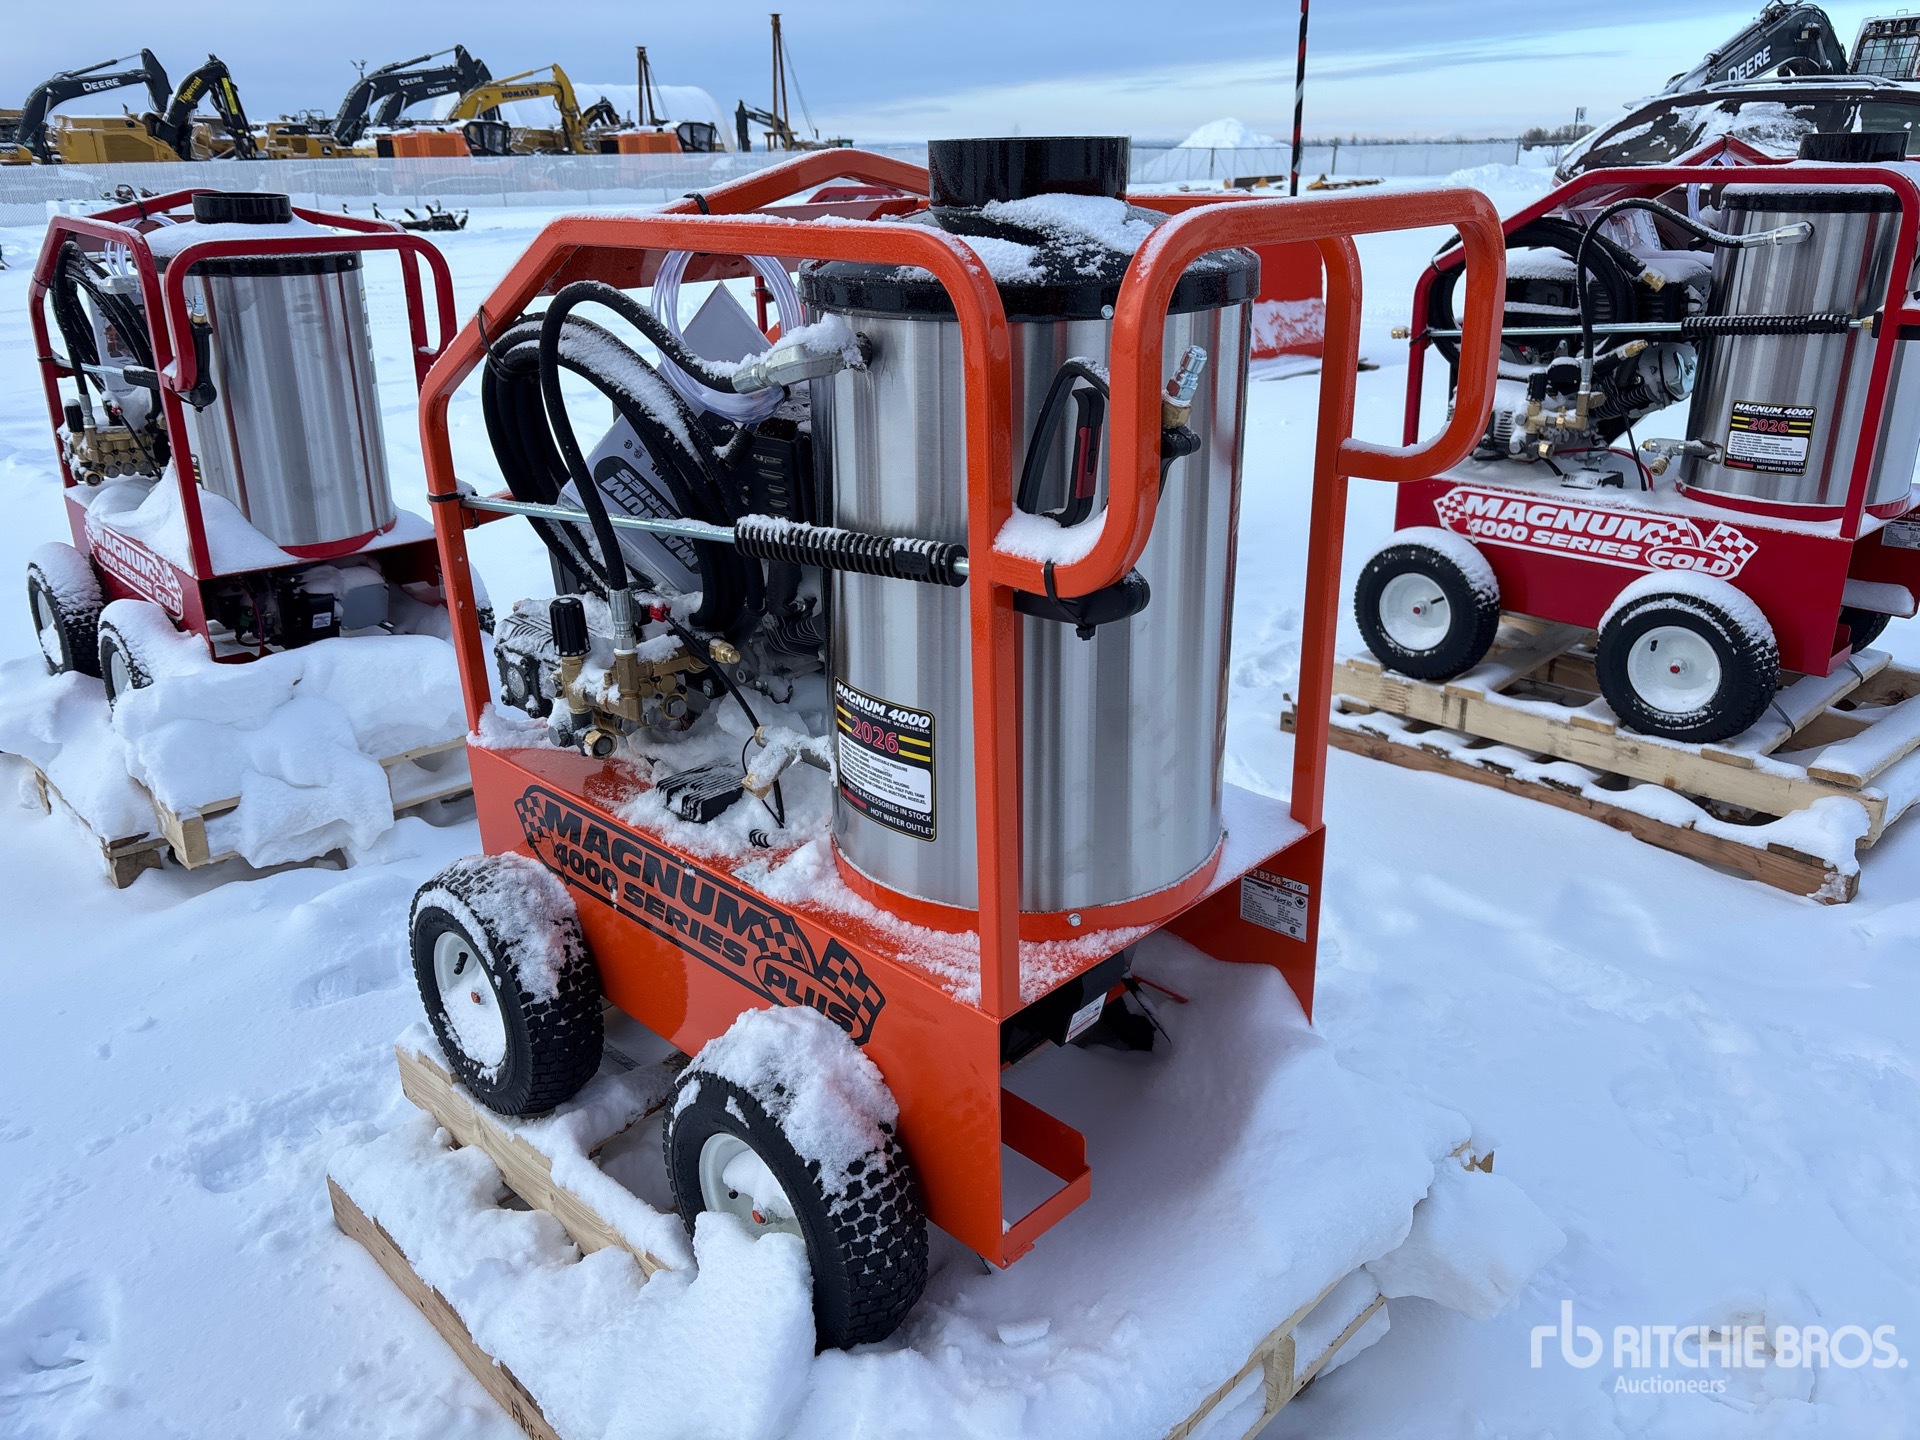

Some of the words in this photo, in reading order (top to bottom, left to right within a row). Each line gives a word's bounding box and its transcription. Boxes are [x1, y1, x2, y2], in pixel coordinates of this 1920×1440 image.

[1727, 44, 1772, 81] DEERE
[82, 78, 121, 92] DEERE
[177, 76, 203, 104] Tigercat
[399, 76, 424, 86] DEERE
[426, 86, 448, 95] DEERE
[501, 89, 540, 99] KOMATSU
[1734, 403, 1783, 414] MAGNUM
[1748, 418, 1789, 433] 2026
[1463, 493, 1659, 544] MAGNUM
[1466, 518, 1529, 543] 4000
[1530, 531, 1641, 560] SERIES
[1650, 549, 1733, 576] GOLD
[118, 562, 152, 594] SERIES
[155, 588, 181, 613] GOLD
[837, 682, 886, 716] MAGNUM
[888, 709, 930, 728] 4000
[844, 700, 860, 711] WATER
[860, 709, 891, 724] PRESSURE
[893, 721, 930, 734] WASHERS
[852, 716, 899, 754] 2026
[890, 763, 908, 772] PRESSURE
[846, 780, 858, 793] PARTS
[863, 792, 899, 813] ACCESSORIES
[908, 810, 931, 822] STOCK
[870, 807, 882, 818] HOT
[883, 814, 905, 827] WATER
[906, 822, 934, 835] OUTLET
[545, 798, 764, 941] MAGNUM
[554, 840, 619, 894] 4000
[623, 881, 748, 968] SERIES
[763, 961, 857, 1035] PLUS
